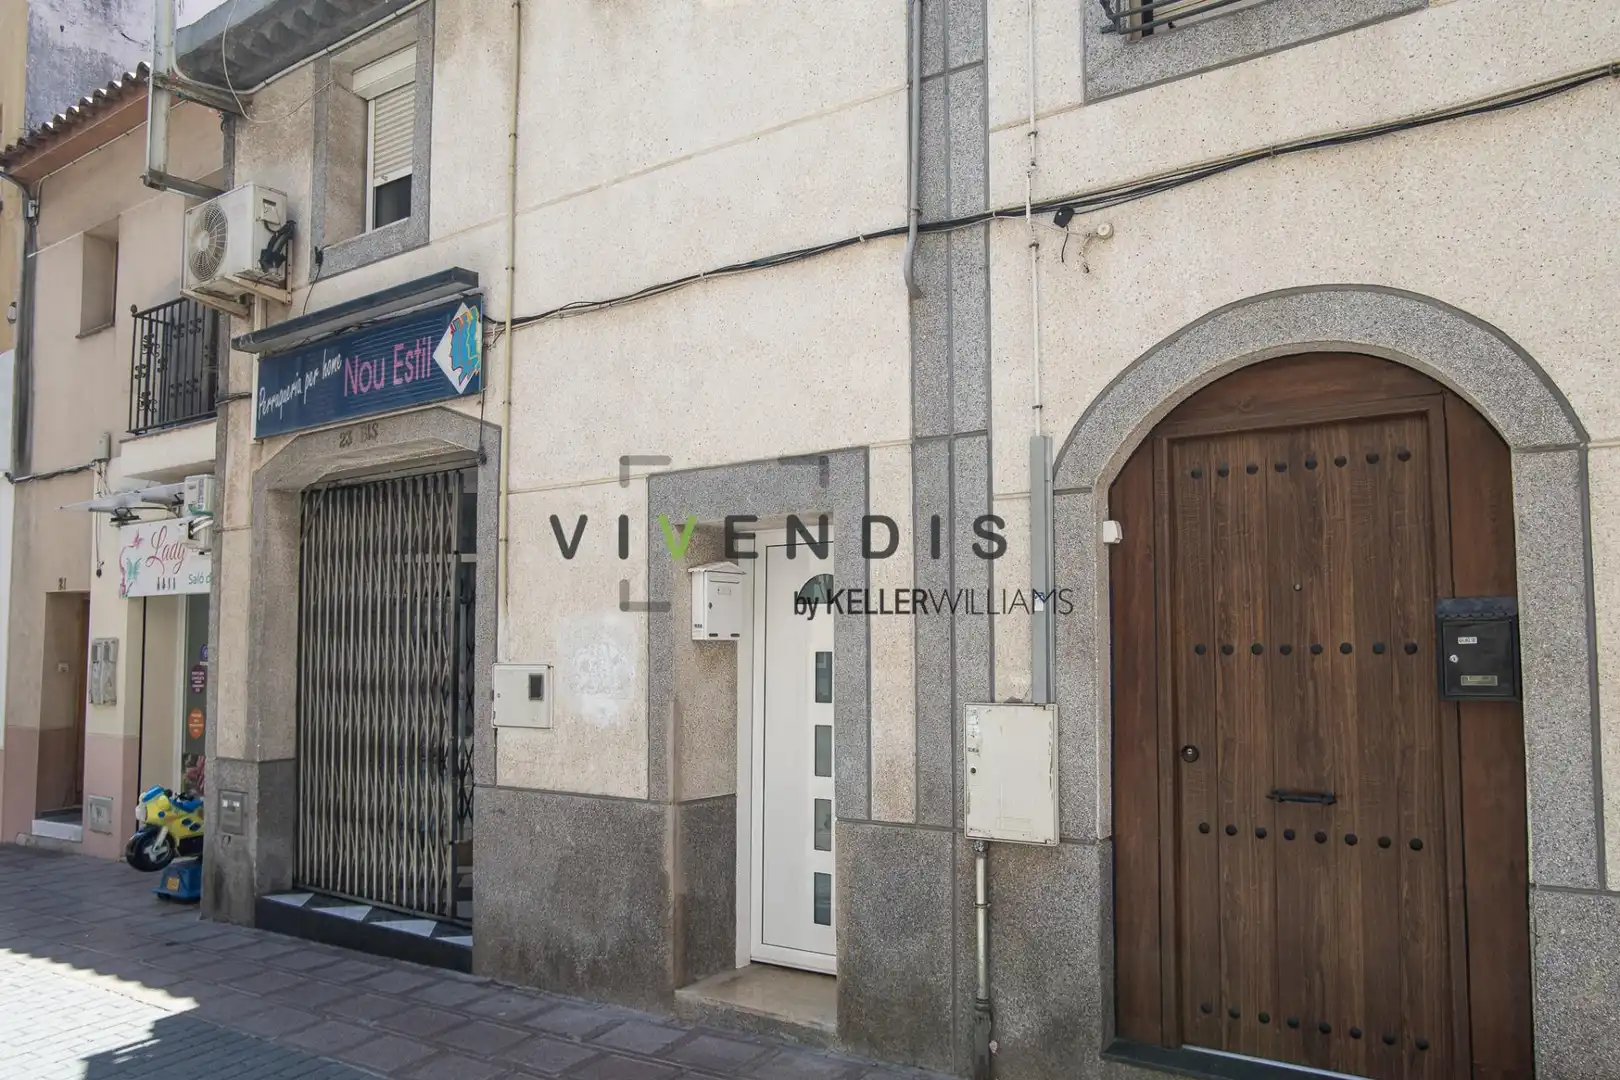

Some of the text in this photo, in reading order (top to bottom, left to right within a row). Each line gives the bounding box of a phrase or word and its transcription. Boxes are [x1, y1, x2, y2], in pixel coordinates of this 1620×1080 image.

[258, 348, 343, 421] Perruqueria per home
[344, 336, 432, 397] Nou Estil
[339, 422, 379, 449] 23 BIS
[145, 525, 186, 575] Lady
